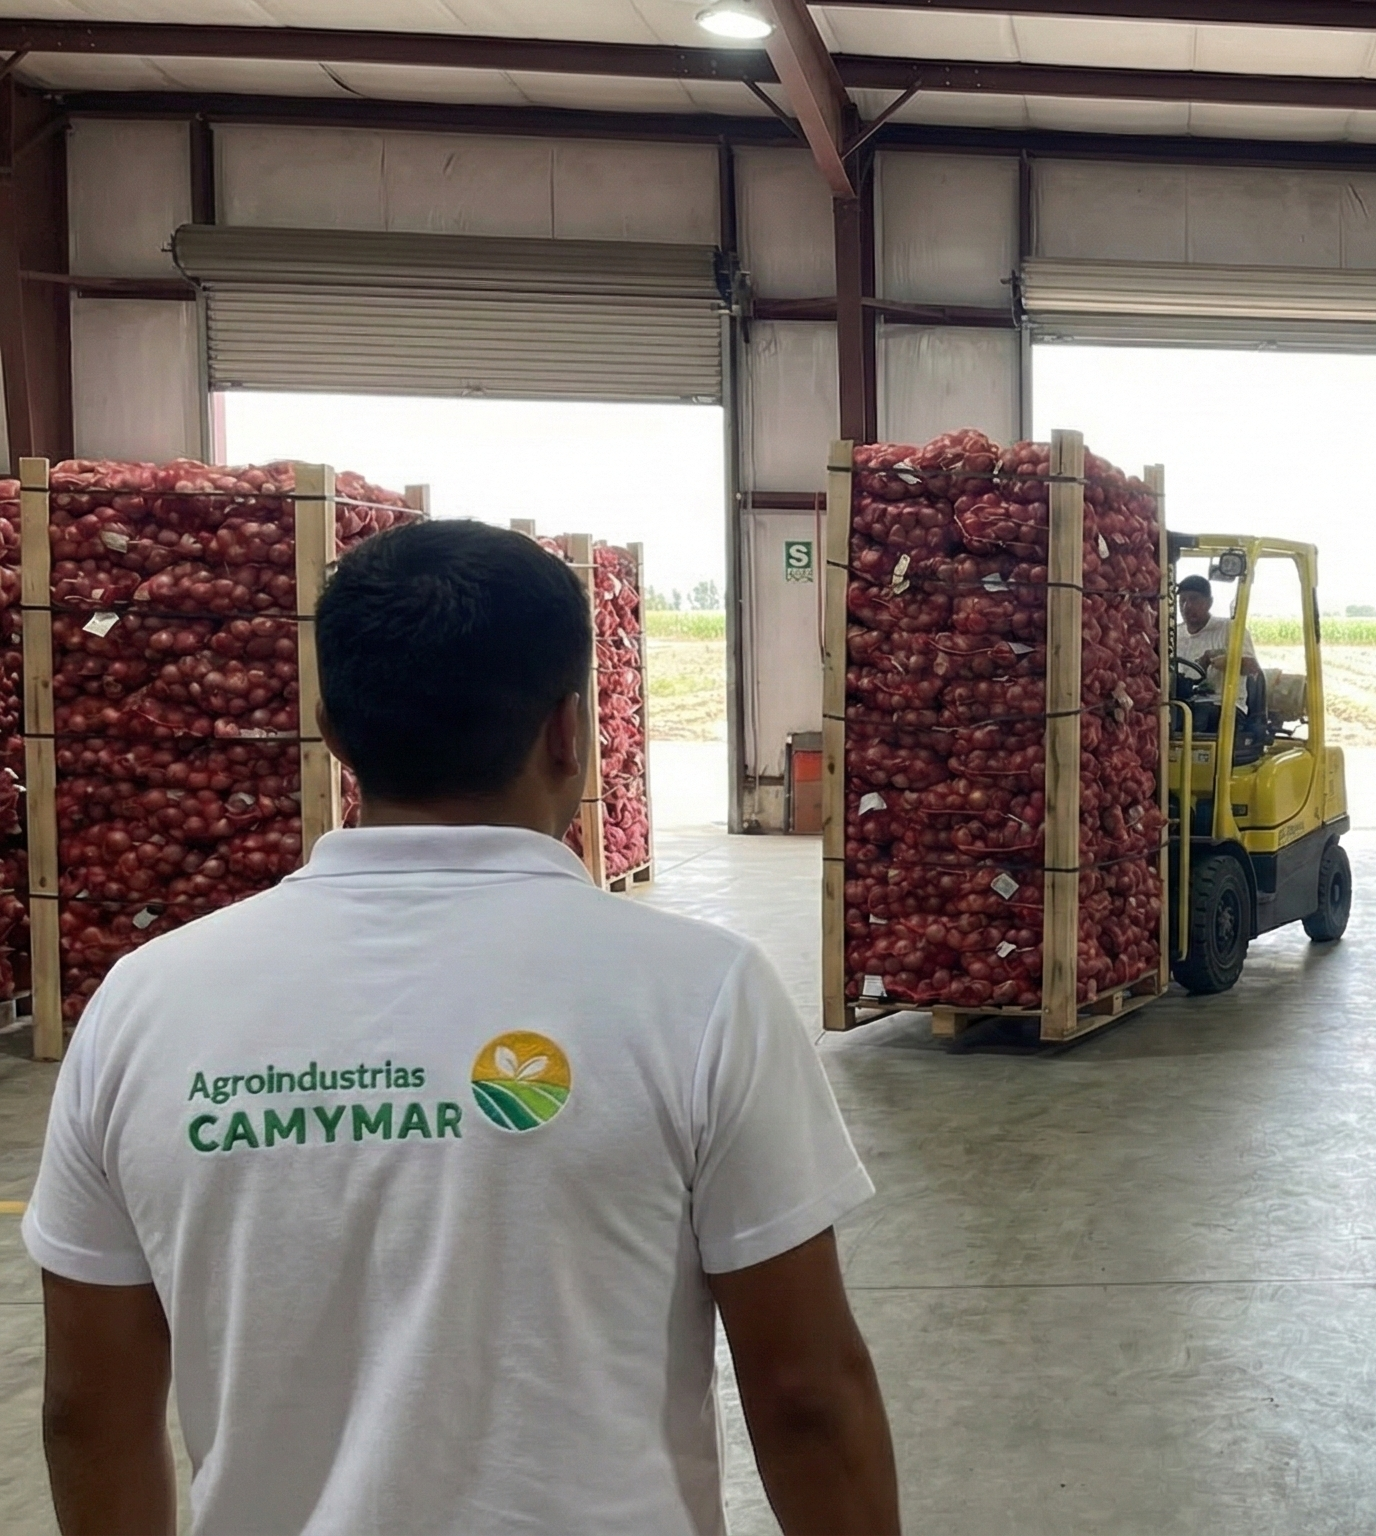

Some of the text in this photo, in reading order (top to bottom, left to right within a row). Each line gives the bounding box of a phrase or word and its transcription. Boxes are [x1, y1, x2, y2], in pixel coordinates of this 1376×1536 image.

[789, 544, 809, 567] S
[188, 1060, 426, 1104] Agroindustrias
[188, 1102, 463, 1152] CAMYMAR
